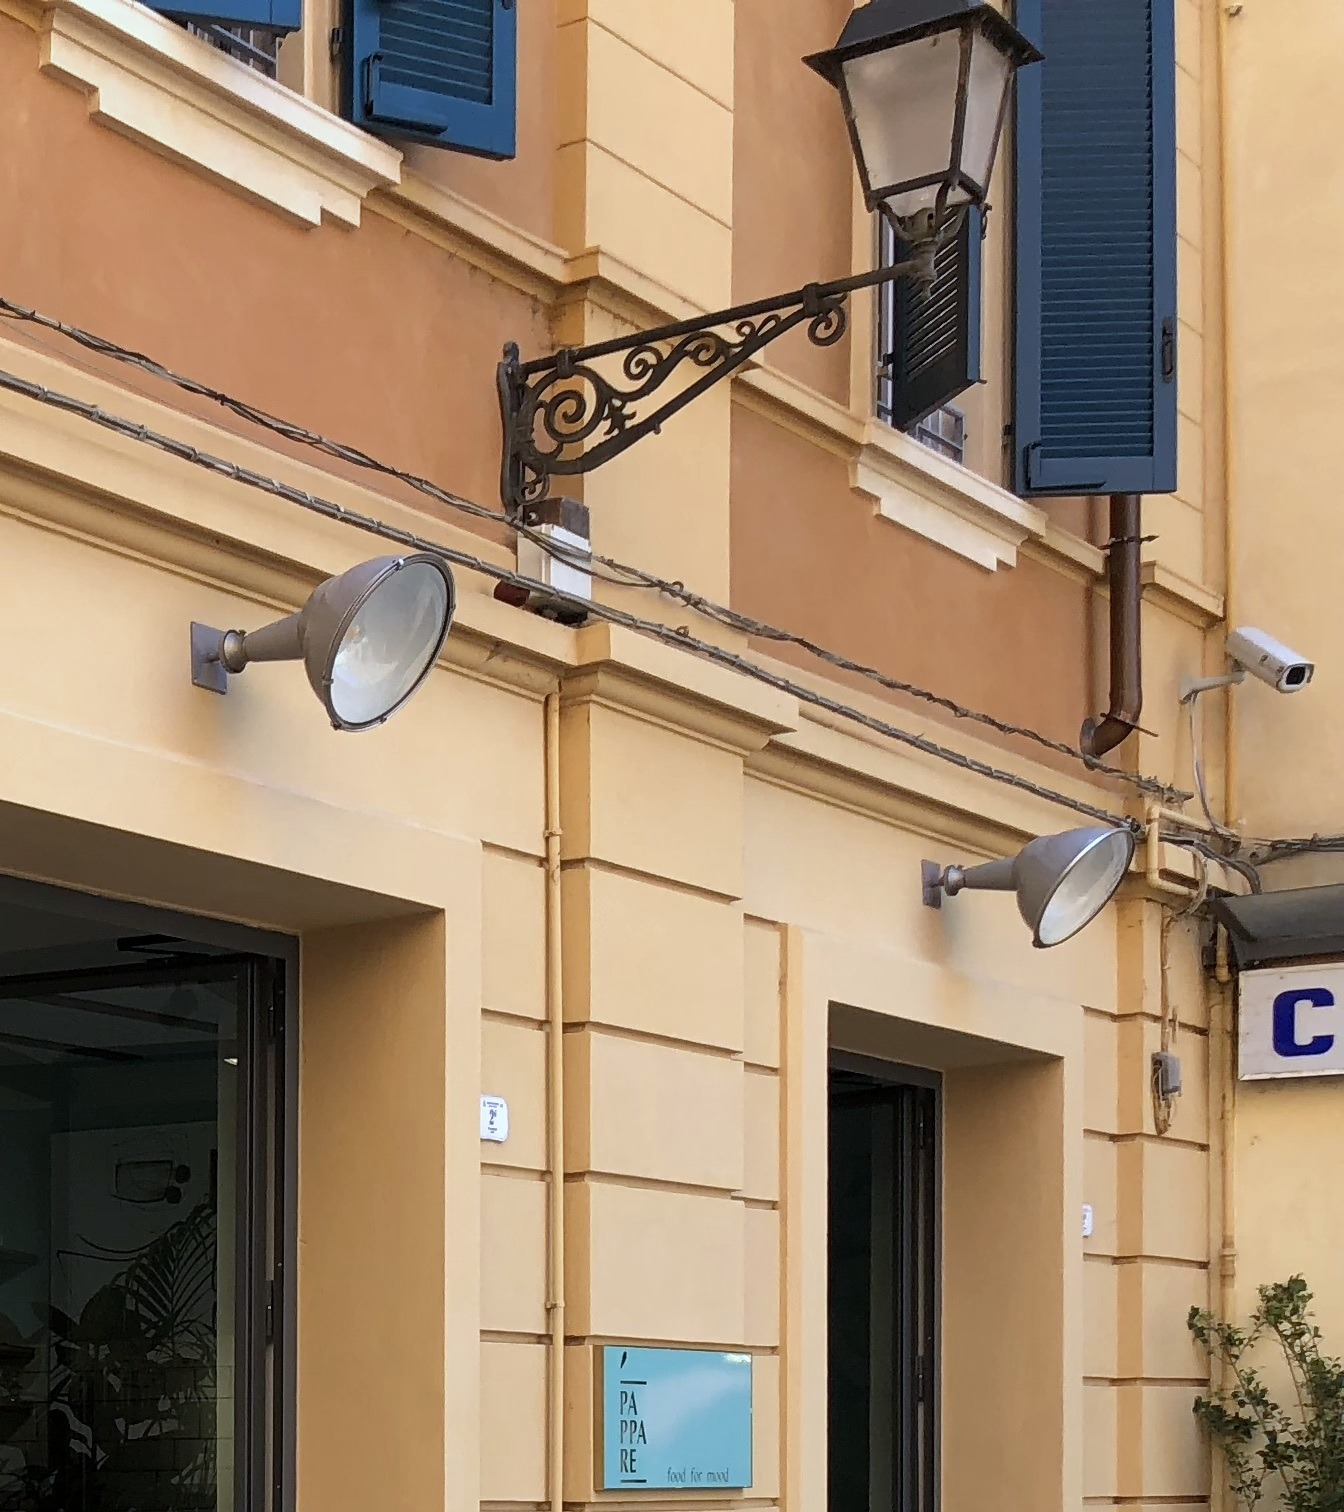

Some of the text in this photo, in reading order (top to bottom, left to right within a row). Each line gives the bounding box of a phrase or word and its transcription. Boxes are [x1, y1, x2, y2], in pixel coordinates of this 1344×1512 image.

[619, 1390, 638, 1416] PA
[619, 1419, 647, 1445] PPA
[620, 1448, 637, 1473] RE
[667, 1466, 730, 1483] food for mood
